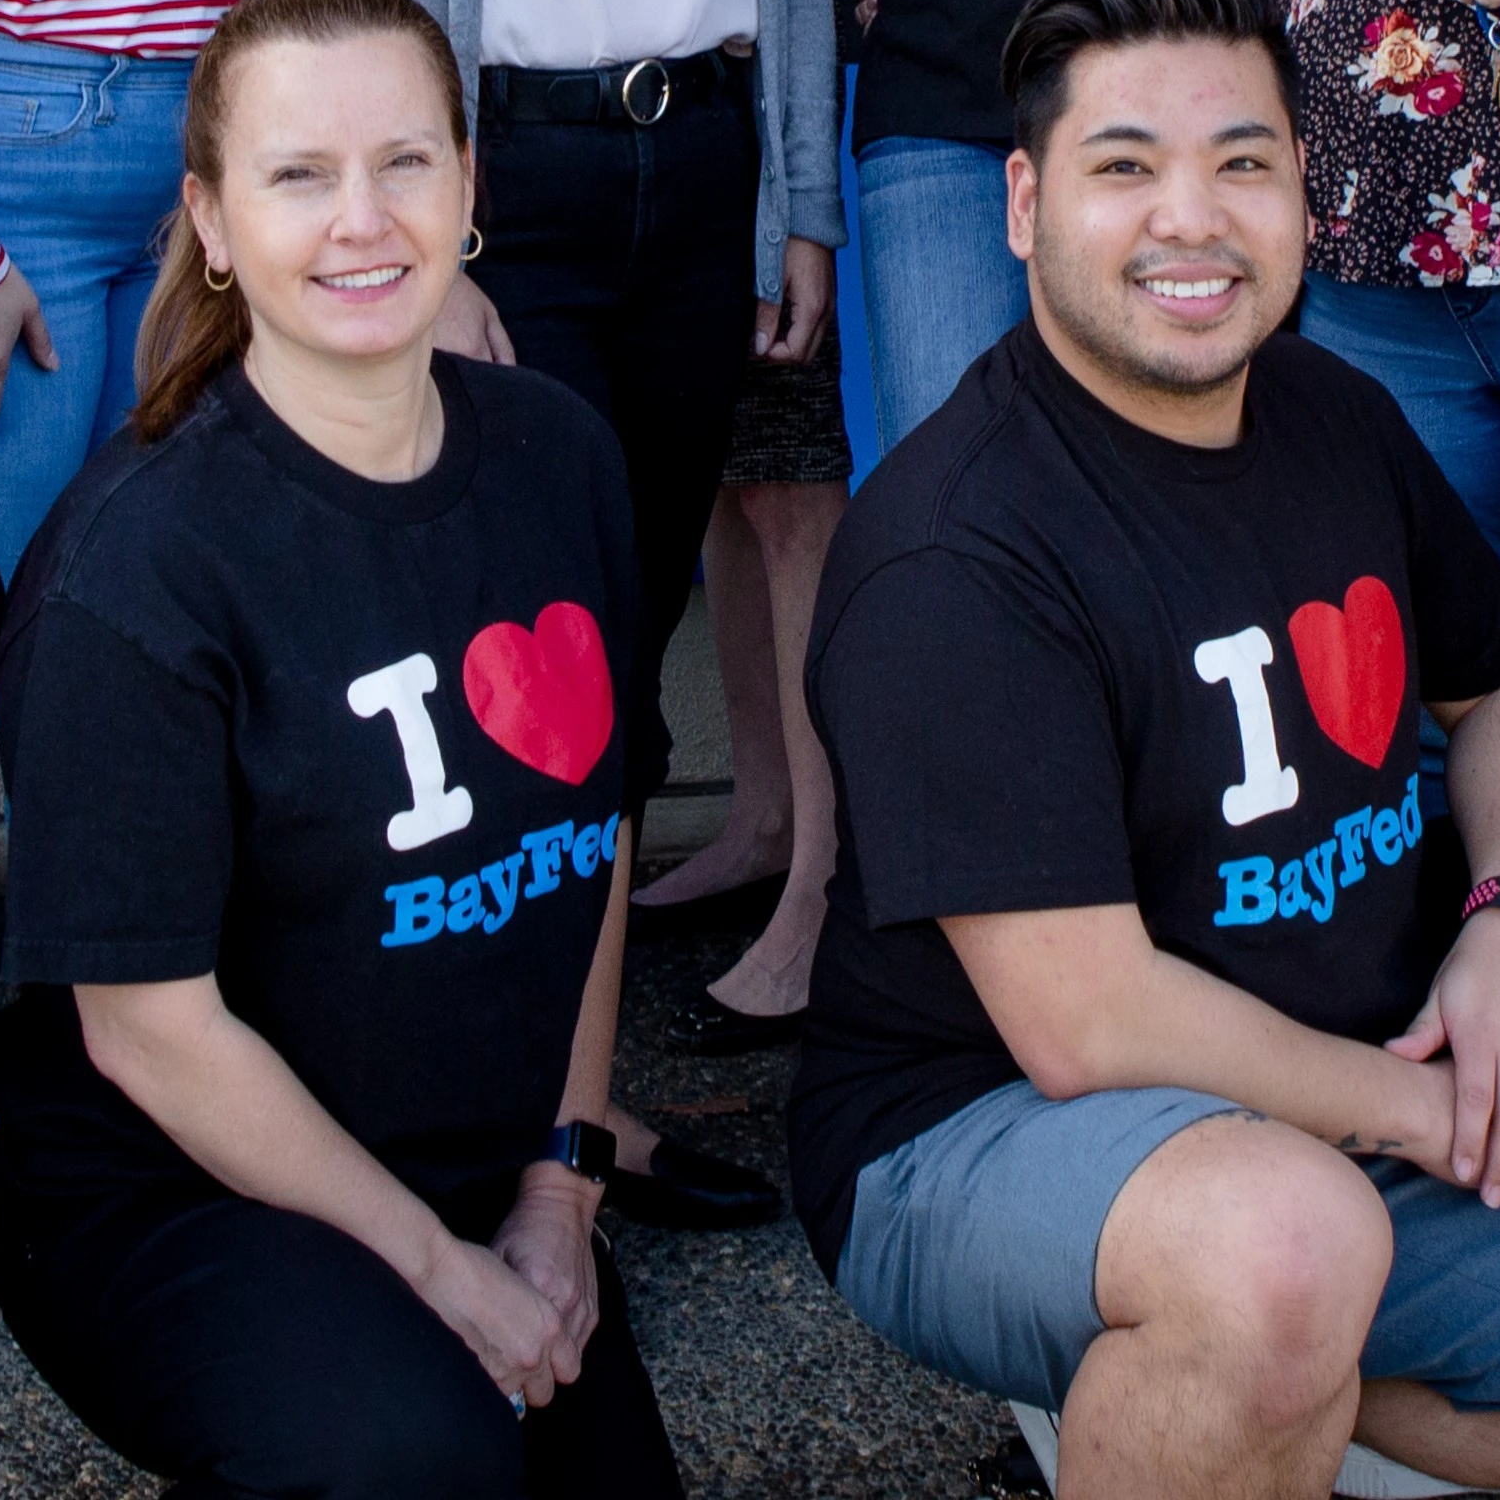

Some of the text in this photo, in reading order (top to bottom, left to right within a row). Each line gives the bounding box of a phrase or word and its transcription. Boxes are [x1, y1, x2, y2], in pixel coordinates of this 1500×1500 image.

[347, 652, 474, 852] I
[1194, 625, 1299, 826] I
[1213, 771, 1424, 927] BayFed
